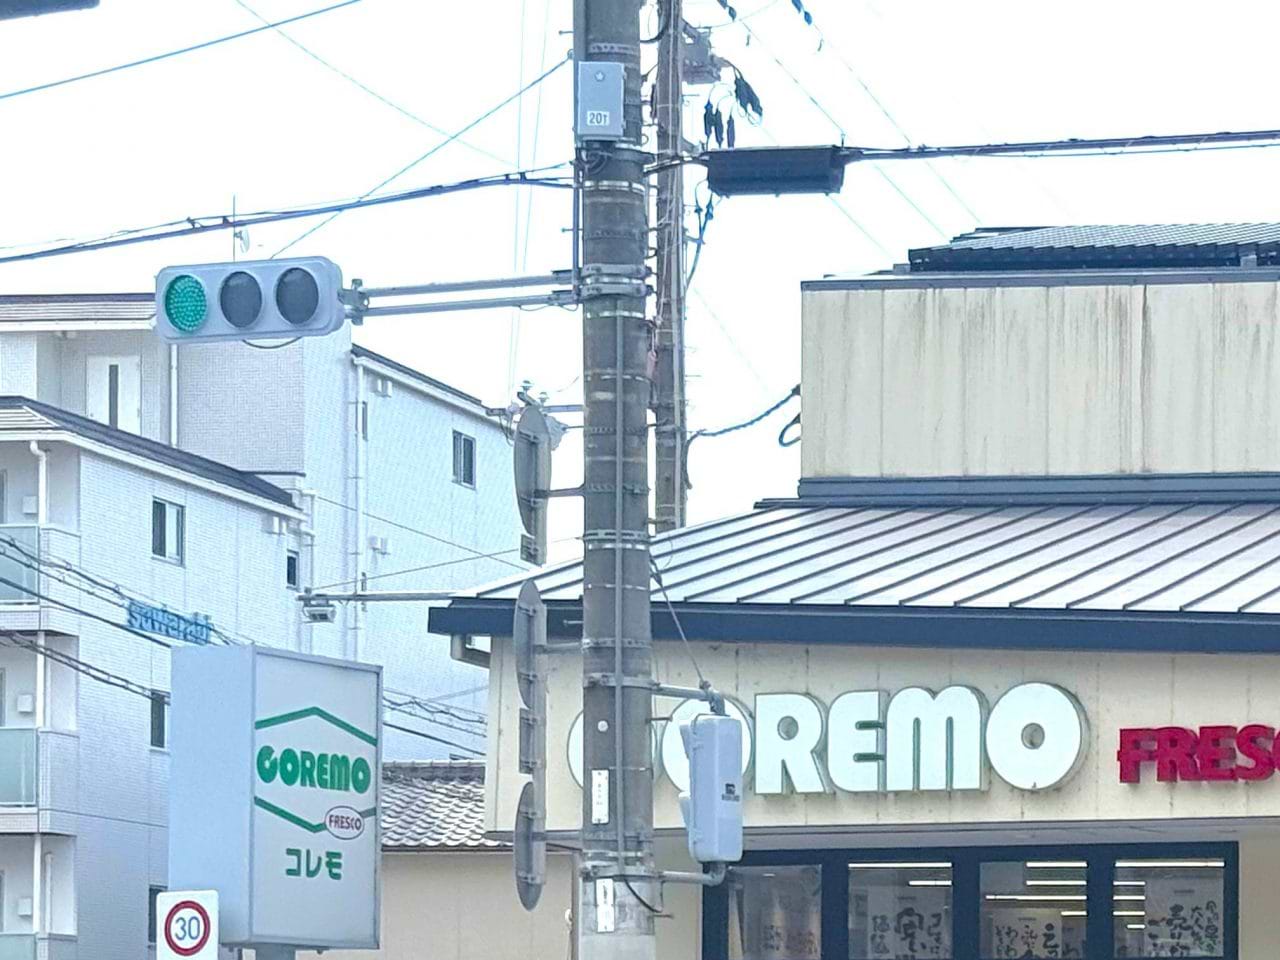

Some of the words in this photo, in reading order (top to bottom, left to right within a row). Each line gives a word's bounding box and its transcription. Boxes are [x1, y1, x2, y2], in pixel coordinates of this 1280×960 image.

[329, 816, 362, 831] FRESCO
[285, 848, 343, 880] コレモ
[175, 916, 201, 941] 30
